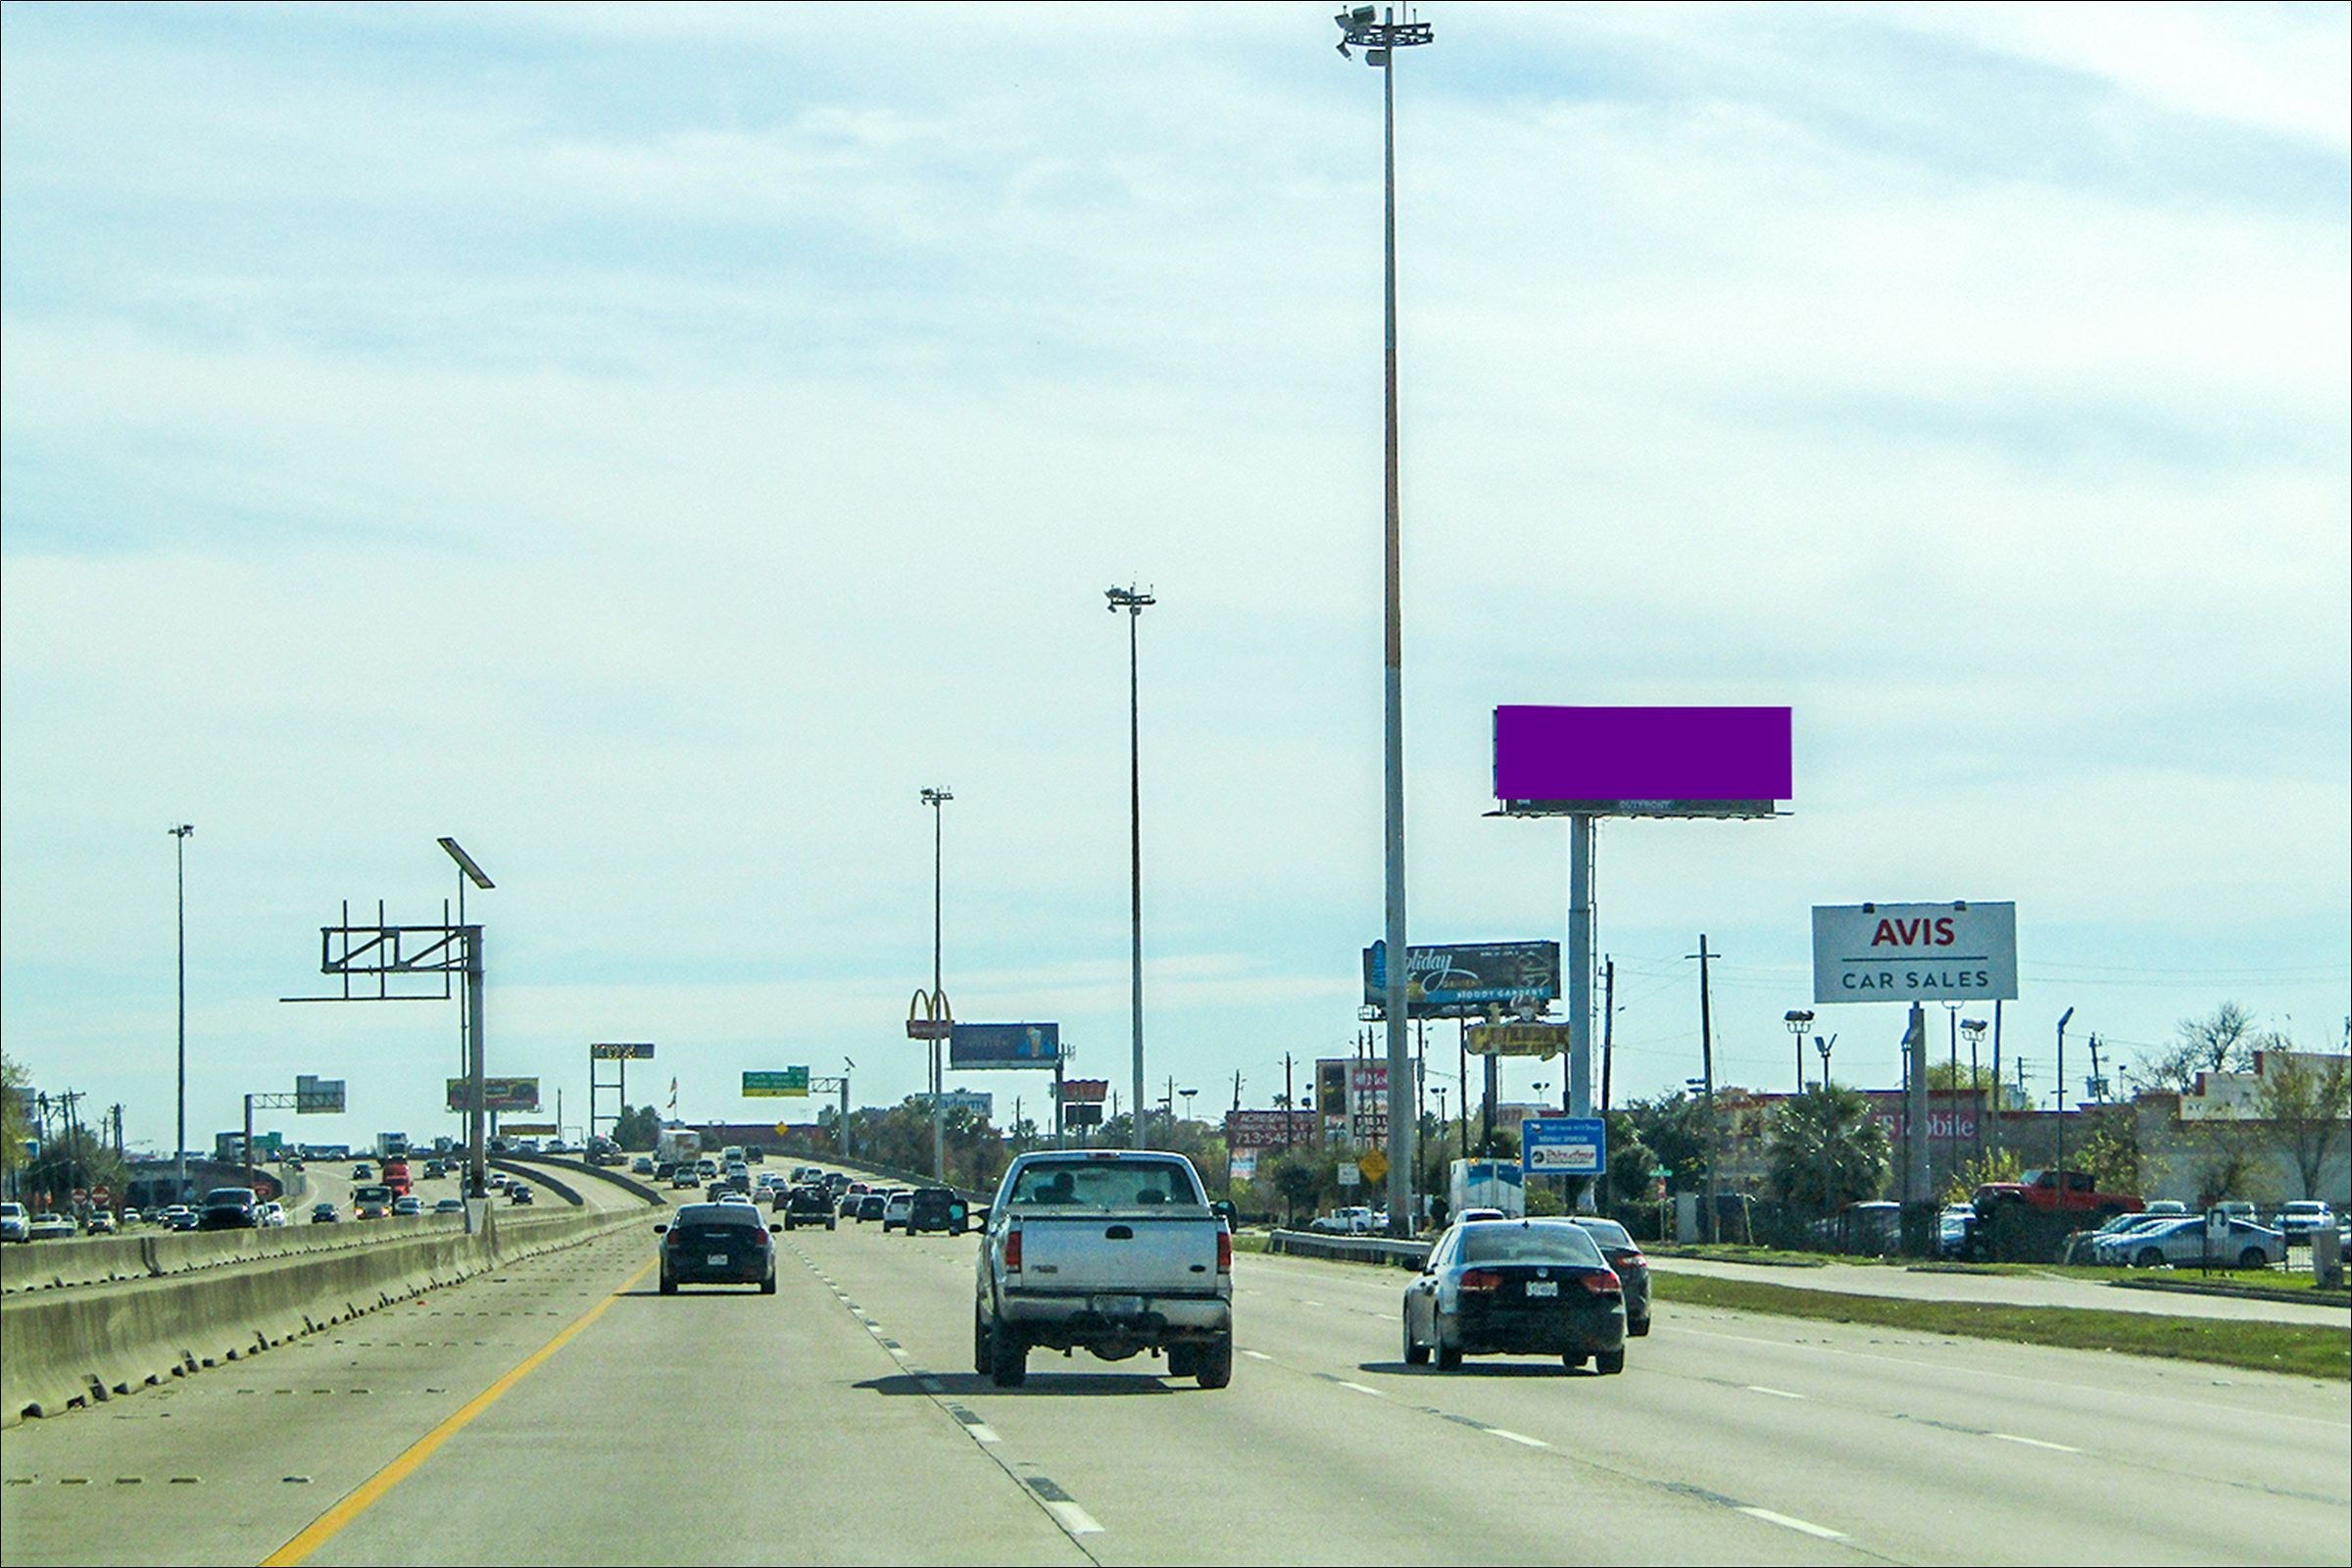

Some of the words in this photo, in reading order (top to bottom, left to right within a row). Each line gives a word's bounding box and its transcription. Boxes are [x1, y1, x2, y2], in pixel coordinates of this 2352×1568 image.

[1871, 917, 1956, 947] AVIS
[1842, 972, 1893, 989] CAR
[1906, 970, 1989, 989] SALES
